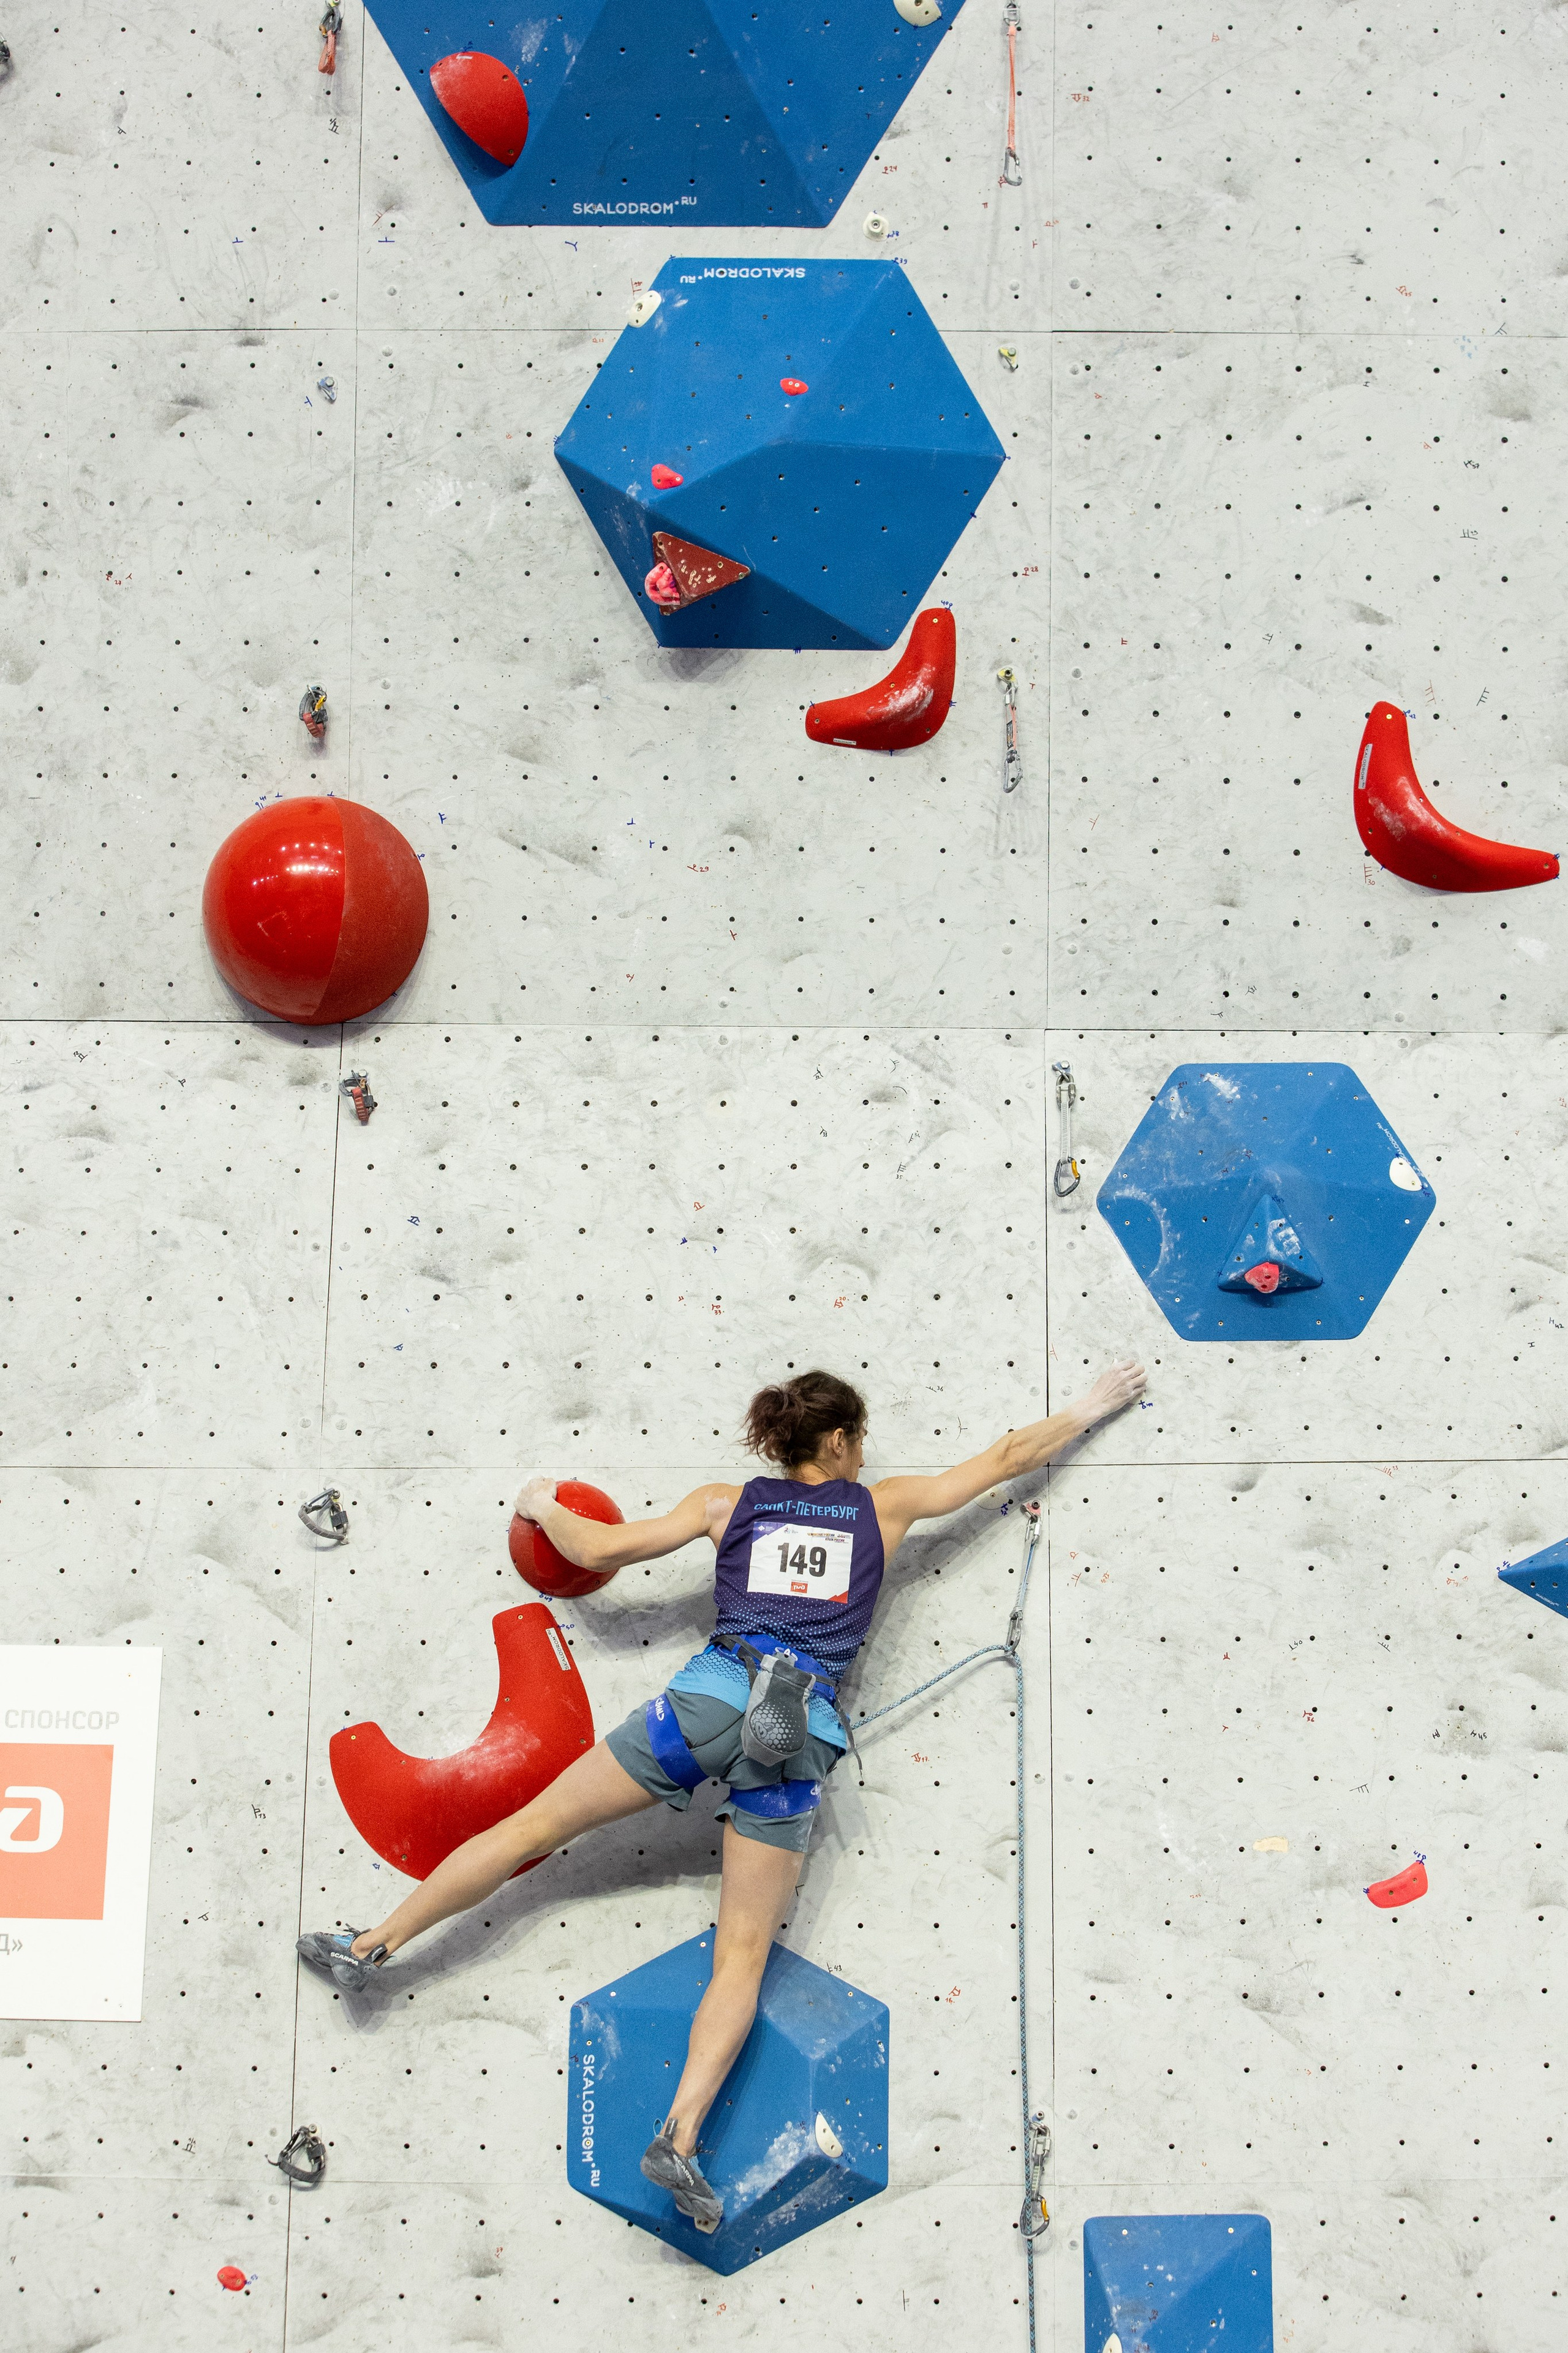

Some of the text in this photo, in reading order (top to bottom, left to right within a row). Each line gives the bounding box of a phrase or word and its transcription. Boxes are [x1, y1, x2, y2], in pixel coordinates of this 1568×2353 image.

[777, 1543, 827, 1577] 149
[5, 1709, 120, 1730] СПОНСОР
[330, 1952, 359, 1966] SCARPA
[673, 2154, 695, 2187] SCARPA
